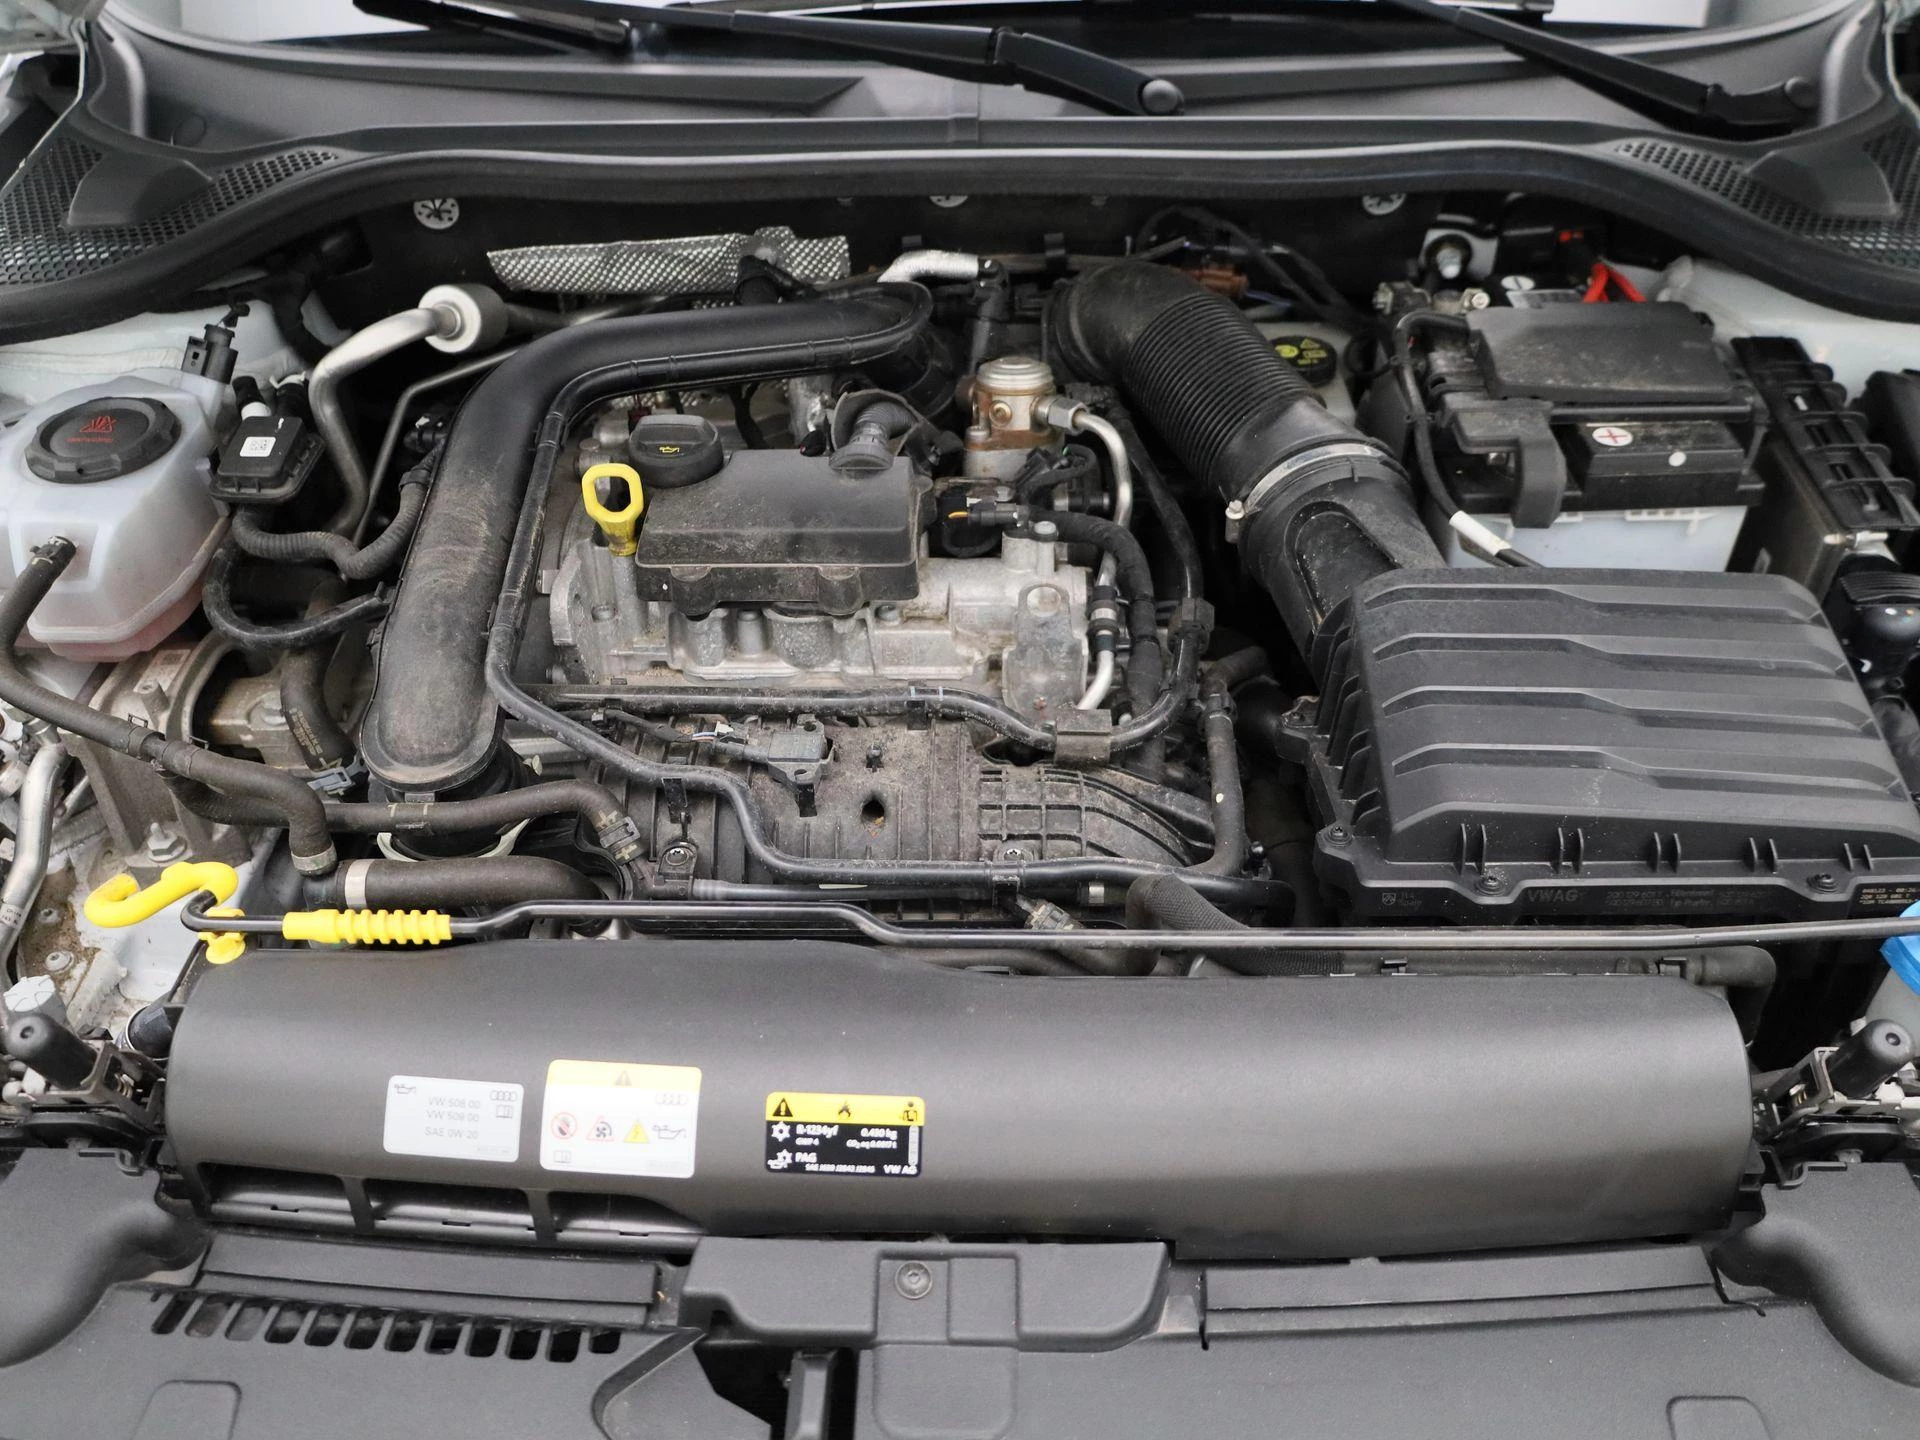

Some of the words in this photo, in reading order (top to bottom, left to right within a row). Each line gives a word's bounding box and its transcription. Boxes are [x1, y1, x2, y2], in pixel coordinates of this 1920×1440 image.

[1526, 888, 1578, 902] VWAG
[424, 1125, 445, 1136] SAE
[795, 1152, 818, 1163] PAG
[883, 1164, 901, 1174] VW
[901, 1165, 918, 1175] AG
